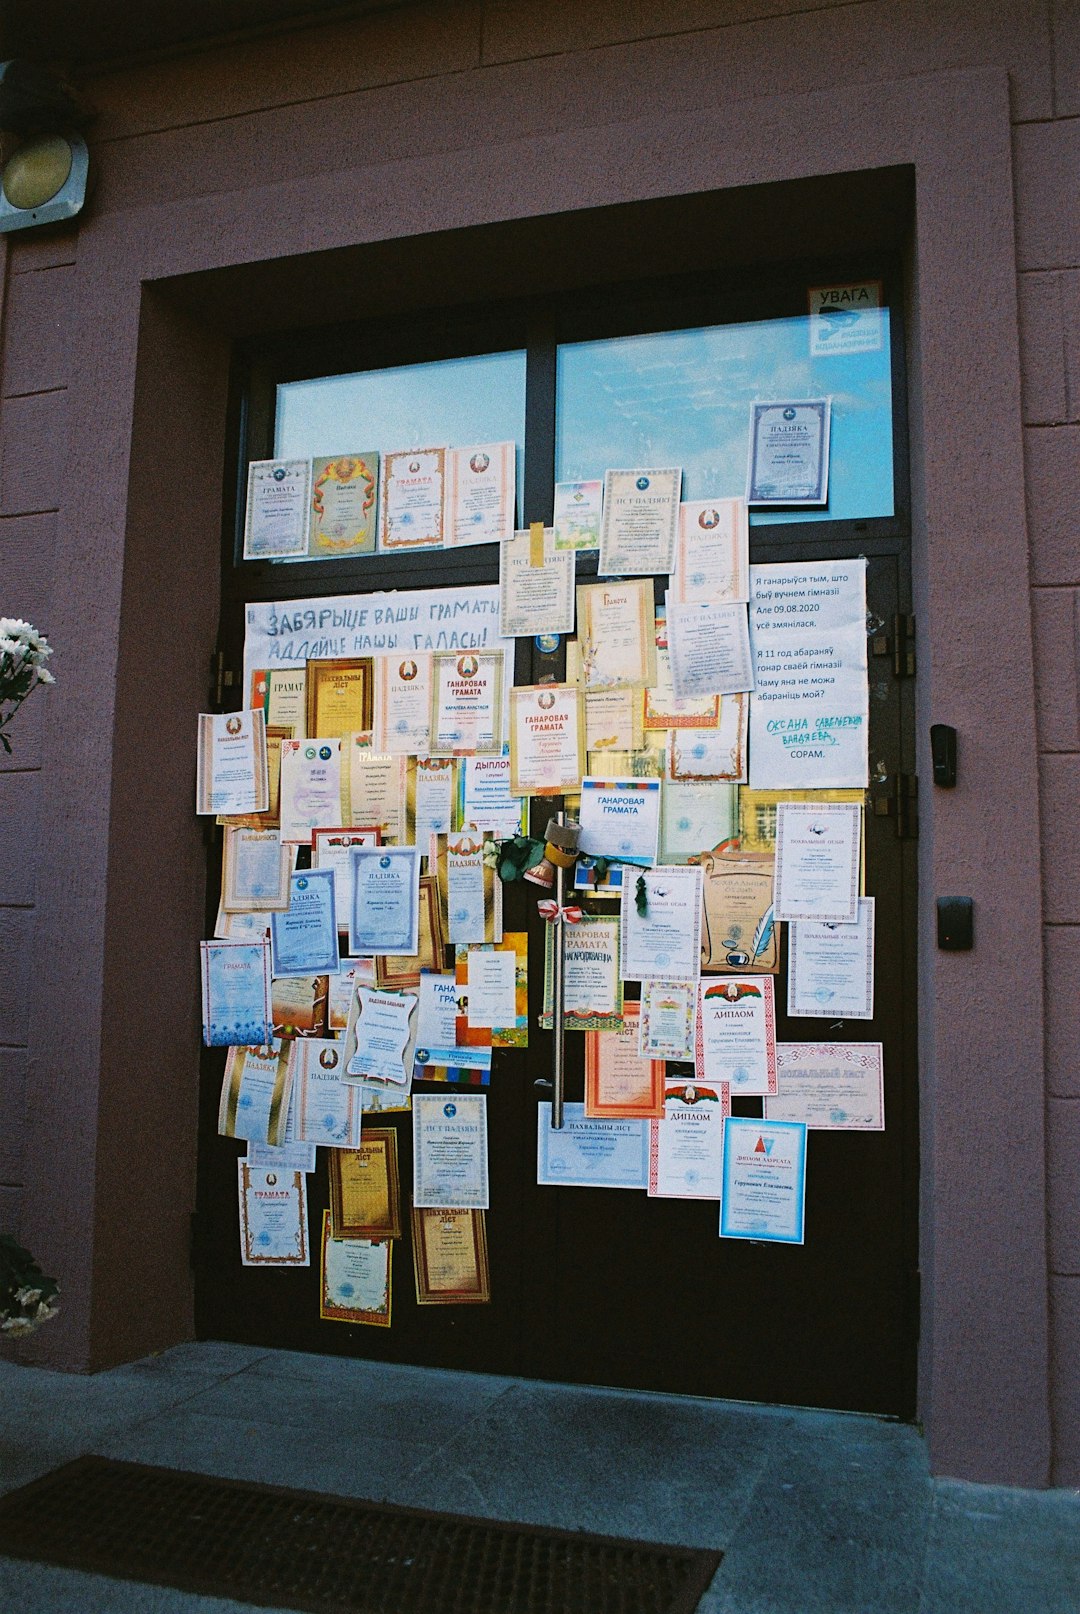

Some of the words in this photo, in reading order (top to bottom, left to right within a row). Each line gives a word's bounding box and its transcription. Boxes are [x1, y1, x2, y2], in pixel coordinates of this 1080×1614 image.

[820, 288, 869, 304] УВАГА
[262, 486, 296, 494] ГРАМАТА
[763, 576, 807, 586] ганарыўся
[810, 575, 830, 583] тым,
[755, 589, 773, 600] быў
[774, 590, 806, 599] вучнем
[807, 587, 840, 597] гімназіі
[756, 606, 772, 614] Але
[774, 604, 820, 614] 09.08.2020
[267, 608, 369, 637] ЗАБЯРЫЦЕ
[375, 606, 419, 626] ВАШЫ
[430, 600, 499, 620] ГРАМАТЫ
[756, 621, 770, 630] усё
[772, 619, 817, 629] змянілася.
[268, 636, 347, 660] АДДАЙЦЕ
[354, 633, 398, 651] НАШЫ
[413, 627, 488, 650] ГАЛАСЫ!
[757, 650, 763, 658] Я
[764, 650, 775, 658] 11
[777, 650, 793, 659] год
[794, 646, 834, 657] абараняў
[757, 664, 781, 673] гонар
[783, 661, 808, 671] сваёй
[810, 661, 842, 670] гімназіі
[447, 679, 487, 688] ГАНАРОВАЯ
[757, 678, 778, 687] Чаму
[780, 678, 796, 686] яна
[811, 676, 835, 685] можа
[274, 682, 304, 692] ГРАМАТ
[391, 684, 425, 693] ПАДЗЯКА
[452, 688, 482, 696] ГРАМАТА
[757, 691, 801, 702] абараніць
[802, 689, 825, 698] мой?
[525, 714, 569, 724] ГАНАРОВАЯ
[530, 723, 564, 732] ГРАМАТА
[766, 717, 808, 732] ОКСАНА
[790, 750, 825, 759] СОРАМ.
[419, 774, 450, 782] ПАДЗЯКА
[597, 796, 645, 805] ГАНАРОВАЯ
[603, 806, 639, 815] ГРАМАТА
[449, 859, 482, 868] ПАДЗЯКА
[564, 931, 610, 939] АНАРОВАЯ
[565, 940, 608, 949] РАМАТА
[564, 951, 613, 963] НАГАРОДЖВАЕЦЦА
[433, 984, 456, 993] ГАНА
[713, 1010, 755, 1019] ДИПЛОМ
[311, 1073, 340, 1081] ПАДЗЯК
[670, 1113, 711, 1121] ДИПЛОМ
[569, 1123, 613, 1131] ПАХВАЛЬНЫ
